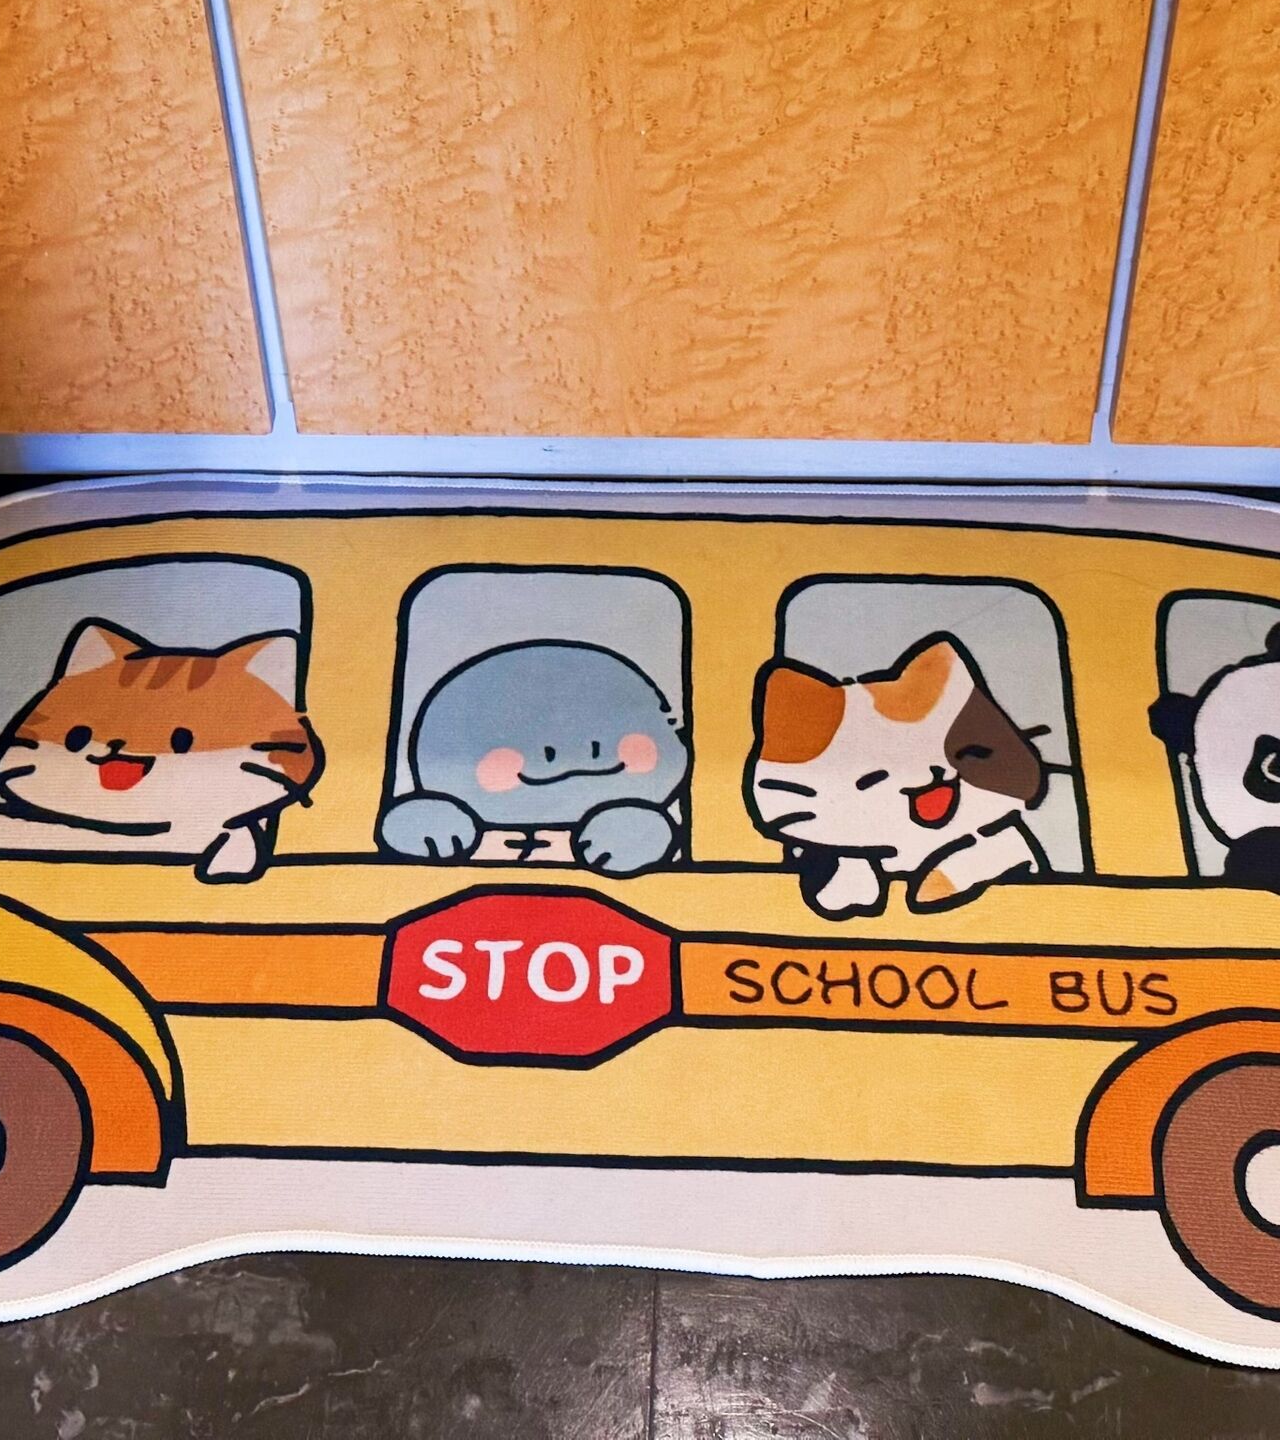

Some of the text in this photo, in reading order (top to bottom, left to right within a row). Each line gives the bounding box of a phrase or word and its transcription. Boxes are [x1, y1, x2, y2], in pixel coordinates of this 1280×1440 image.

[417, 939, 647, 1005] STOP
[725, 959, 1179, 1016] SCHOOL BUS
